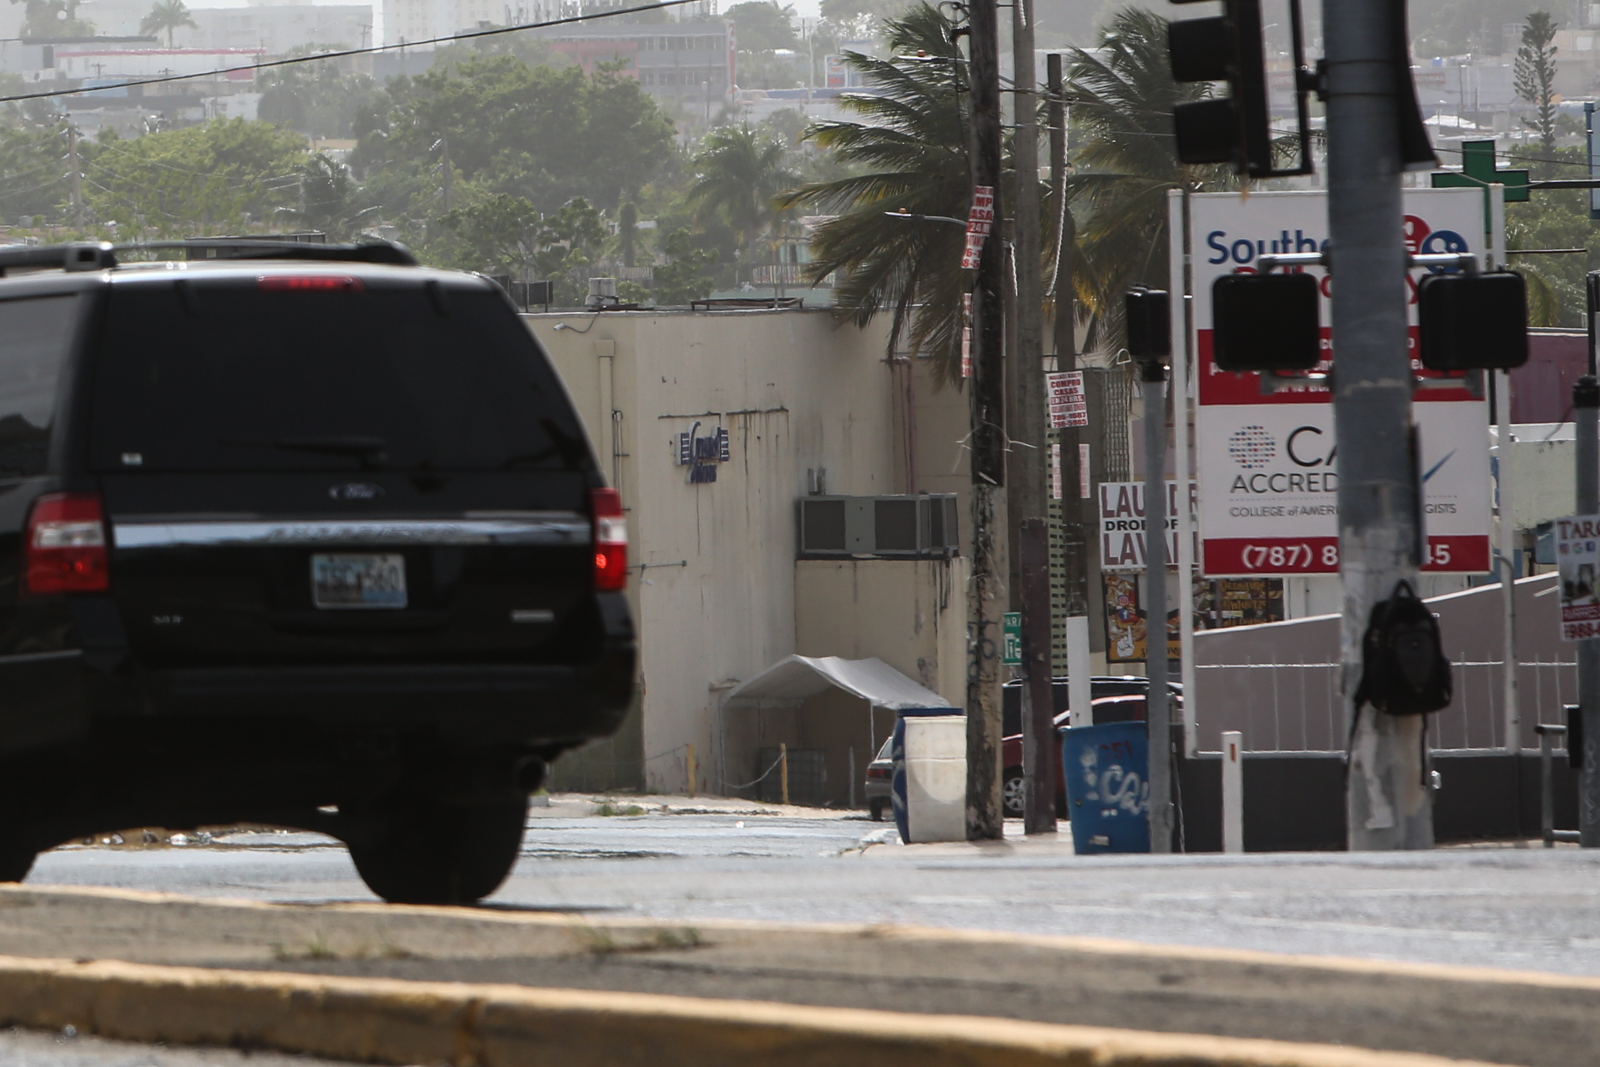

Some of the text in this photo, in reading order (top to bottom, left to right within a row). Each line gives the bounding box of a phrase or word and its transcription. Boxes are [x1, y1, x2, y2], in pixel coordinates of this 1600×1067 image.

[1054, 387, 1079, 395] CASAS
[1230, 473, 1338, 494] ACCRED
[1229, 505, 1285, 518] COLLEGE
[1300, 504, 1338, 516] AMERI
[1105, 520, 1146, 531] DRO
[1241, 544, 1313, 569] (787)
